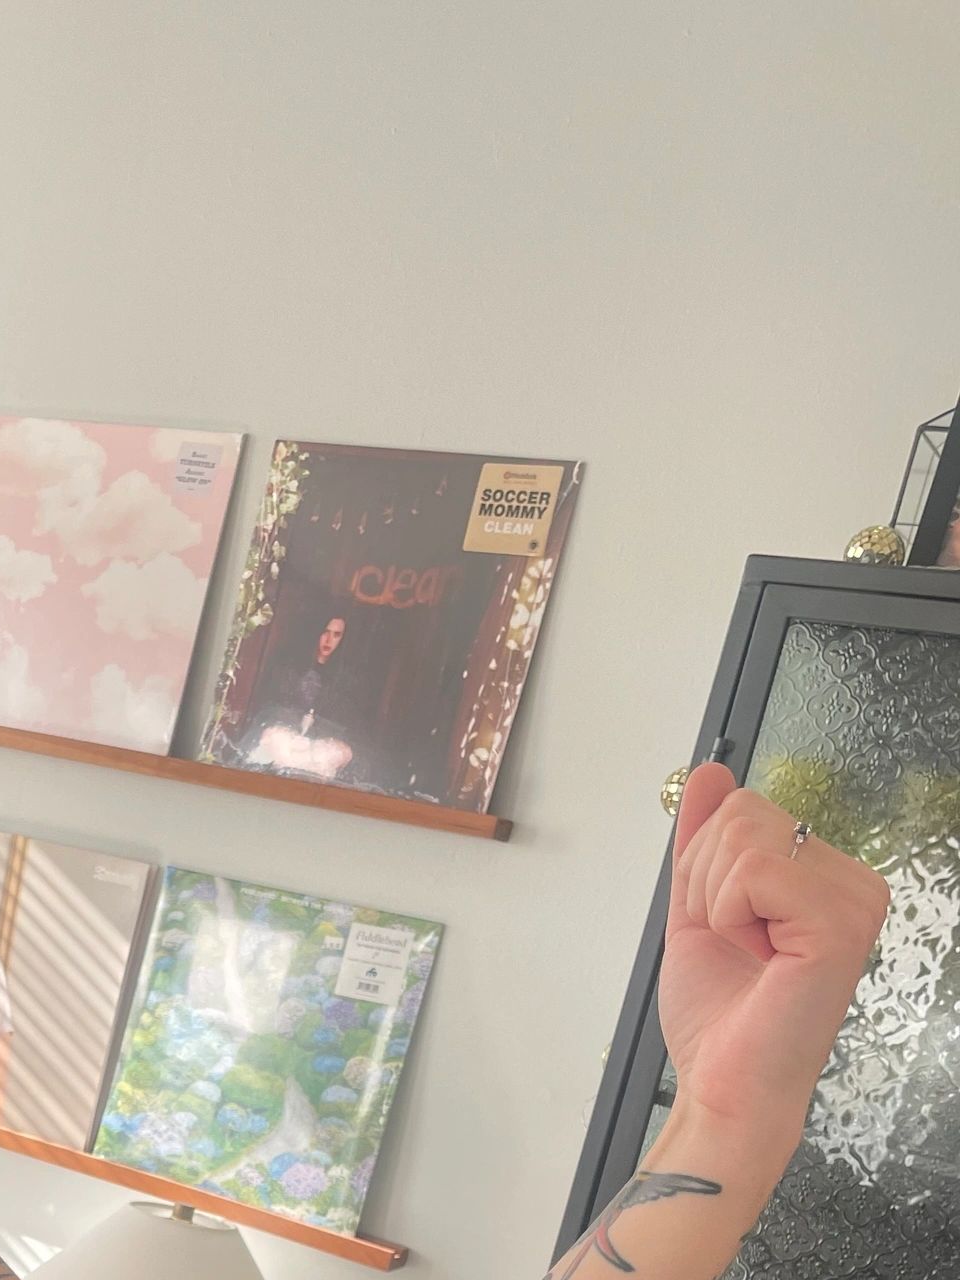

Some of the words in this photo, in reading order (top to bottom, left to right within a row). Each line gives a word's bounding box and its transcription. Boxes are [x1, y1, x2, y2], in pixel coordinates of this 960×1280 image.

[481, 488, 551, 506] SOCCER
[478, 503, 548, 520] MOMMY
[483, 520, 535, 536] CLEAN
